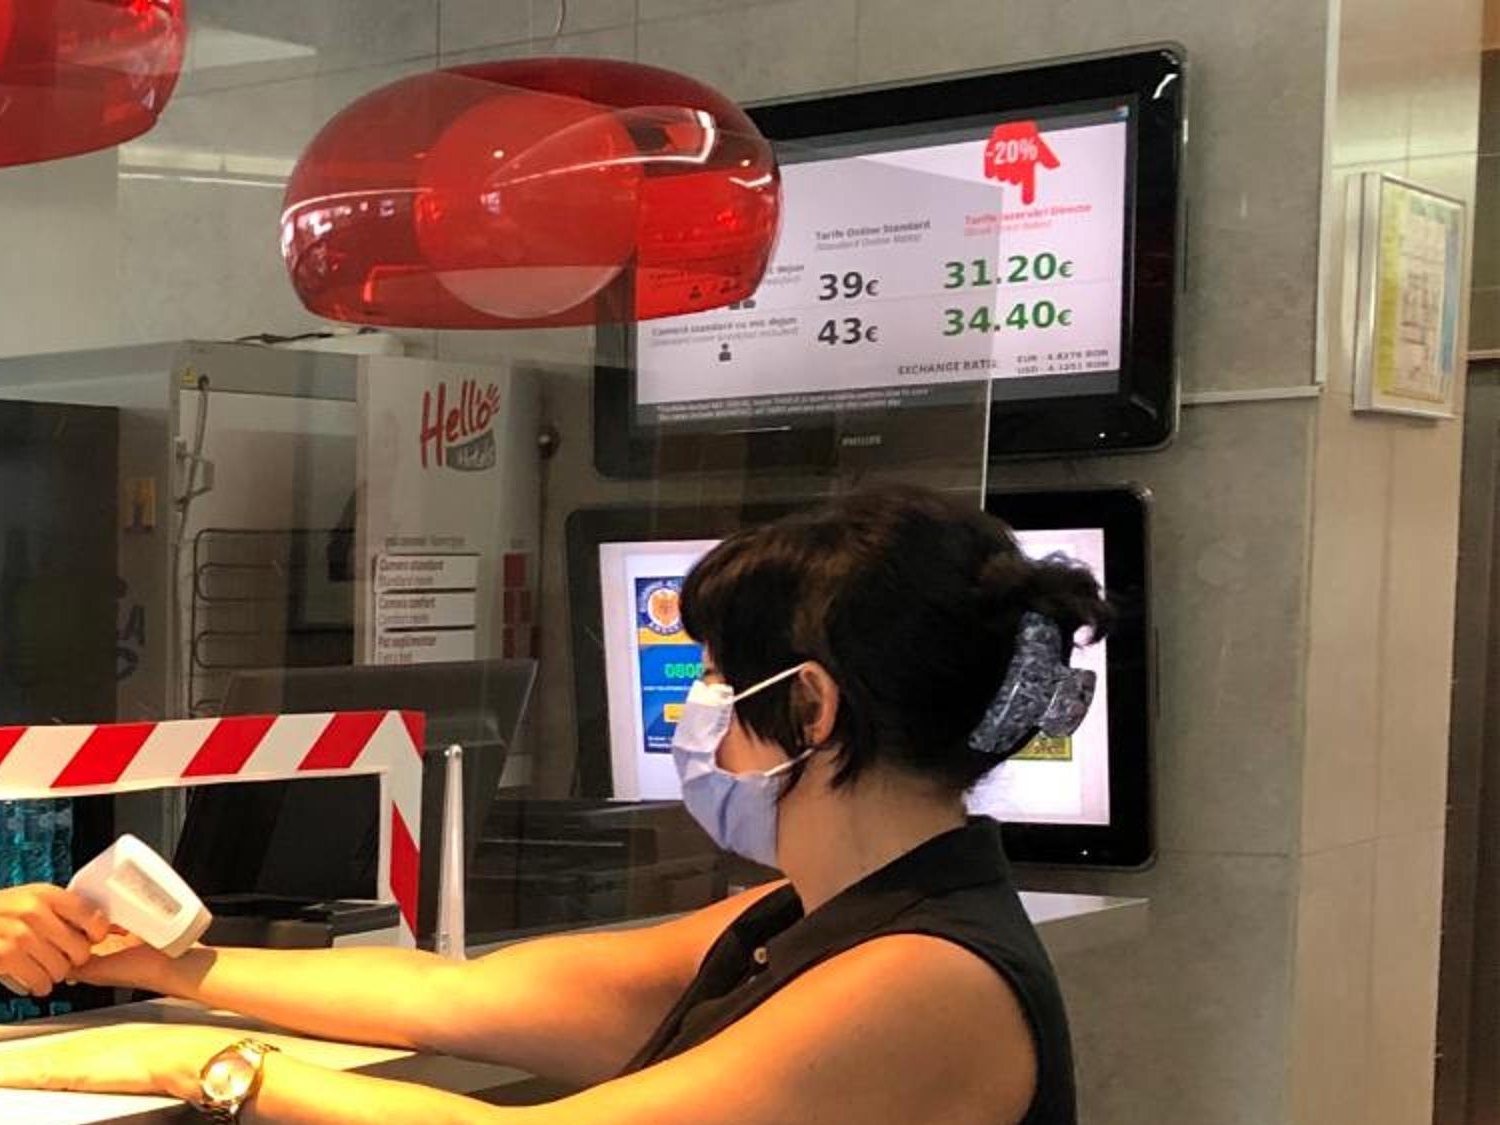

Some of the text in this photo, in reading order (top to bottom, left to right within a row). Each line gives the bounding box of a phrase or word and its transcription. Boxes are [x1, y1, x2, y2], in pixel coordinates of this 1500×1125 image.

[985, 138, 1038, 165] -20%
[883, 219, 931, 234] Standard
[943, 252, 1075, 289] 31.20€
[818, 271, 880, 301] 39€
[817, 317, 879, 346] 43€
[942, 300, 1073, 337] 34.40€
[898, 361, 959, 375] EXCHANGE
[419, 379, 493, 468] Hello
